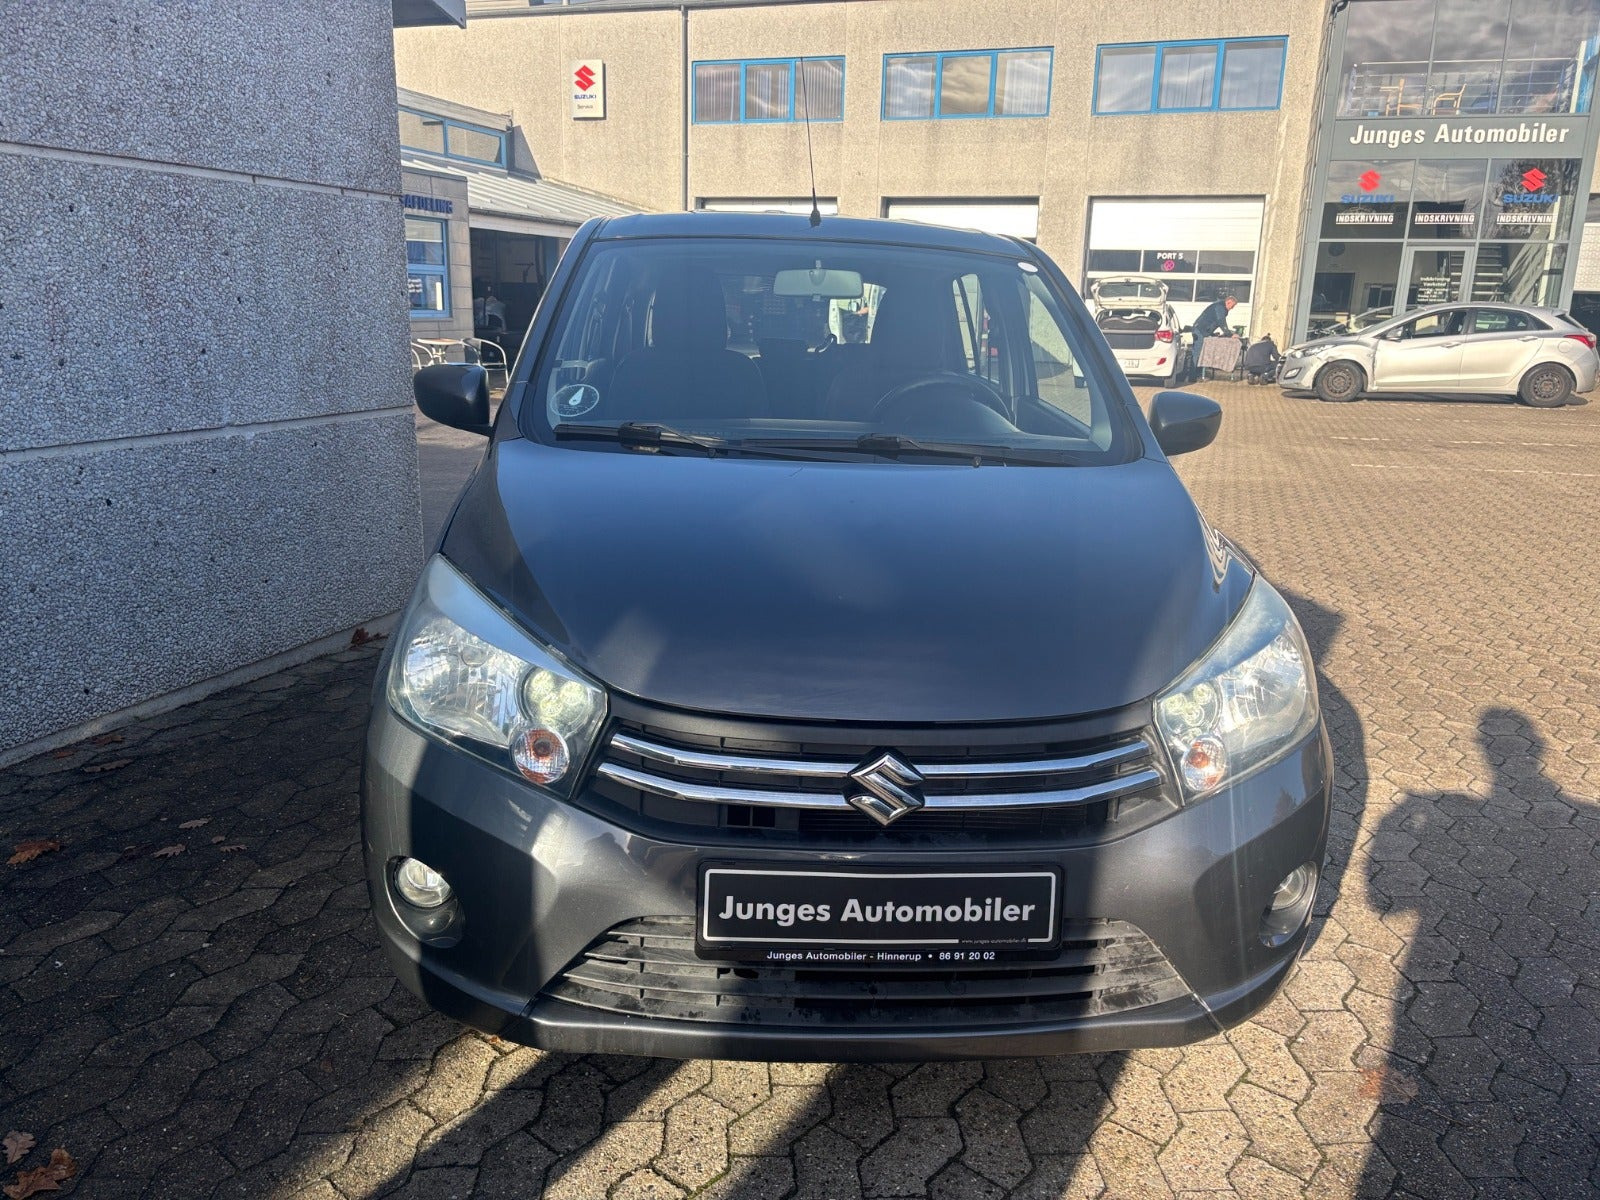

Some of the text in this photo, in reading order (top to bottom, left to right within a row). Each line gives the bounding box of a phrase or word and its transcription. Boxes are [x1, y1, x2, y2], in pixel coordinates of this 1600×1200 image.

[1350, 123, 1570, 149] Junges Automobiler
[1340, 194, 1395, 204] SUZUKI
[1502, 194, 1561, 204] SUZUKI
[1336, 214, 1394, 223] INDSKRIVNING
[1415, 214, 1475, 223] INDSKRIVNING
[1497, 214, 1558, 223] INDSKRIVNING
[718, 895, 1036, 928] Junges Automobiler
[766, 951, 803, 962] Junges
[806, 951, 867, 961] Automobiler
[877, 951, 922, 962] Hinnerup
[939, 952, 951, 960] 86
[953, 952, 965, 960] 91
[968, 952, 981, 960] 20
[983, 952, 995, 960] 02
